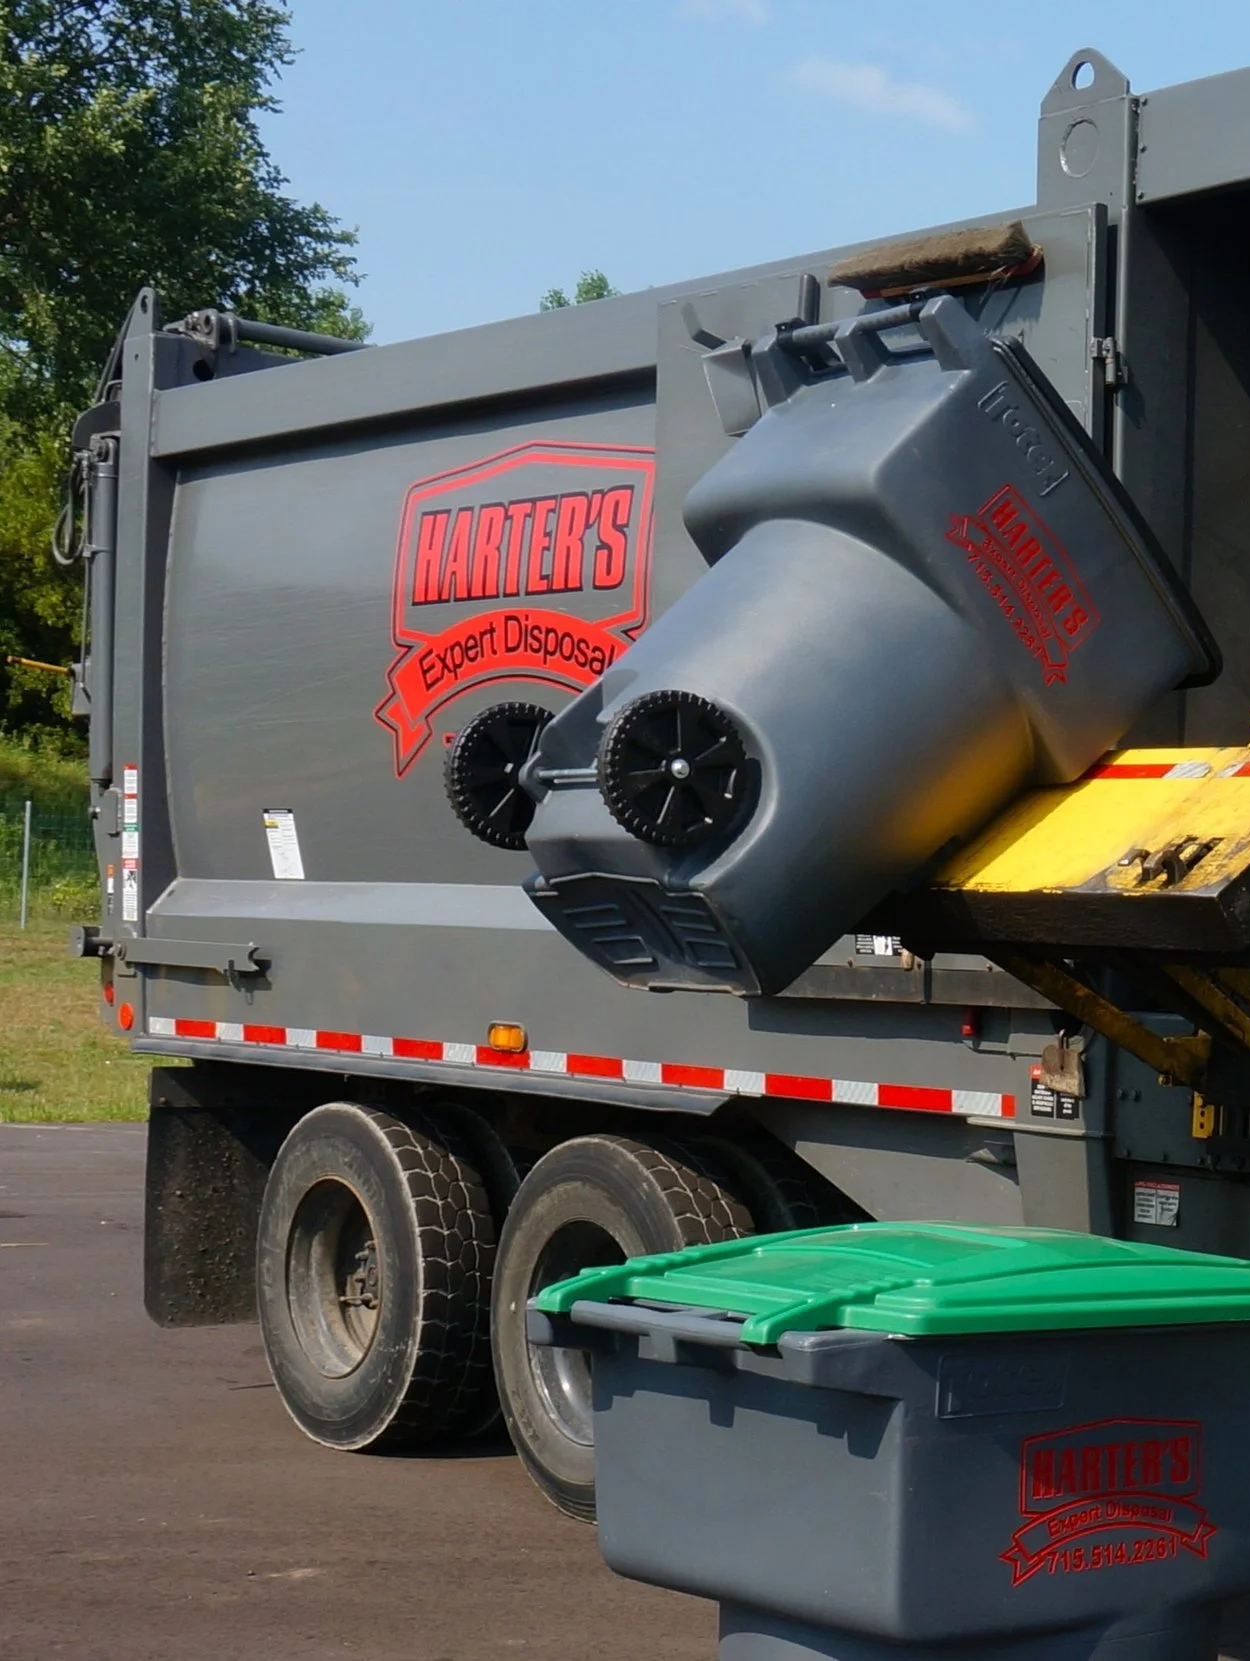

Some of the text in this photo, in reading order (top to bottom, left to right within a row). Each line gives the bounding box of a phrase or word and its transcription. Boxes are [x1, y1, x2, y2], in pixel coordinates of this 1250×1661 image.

[411, 485, 634, 606] HARTER'S
[991, 500, 1088, 636] HARTER'S
[418, 615, 615, 691] Expert Disposal
[1032, 1437, 1192, 1499] HARTER'S
[1048, 1500, 1174, 1537] Expert Disposal
[1047, 1536, 1178, 1573] 715.514.2261
